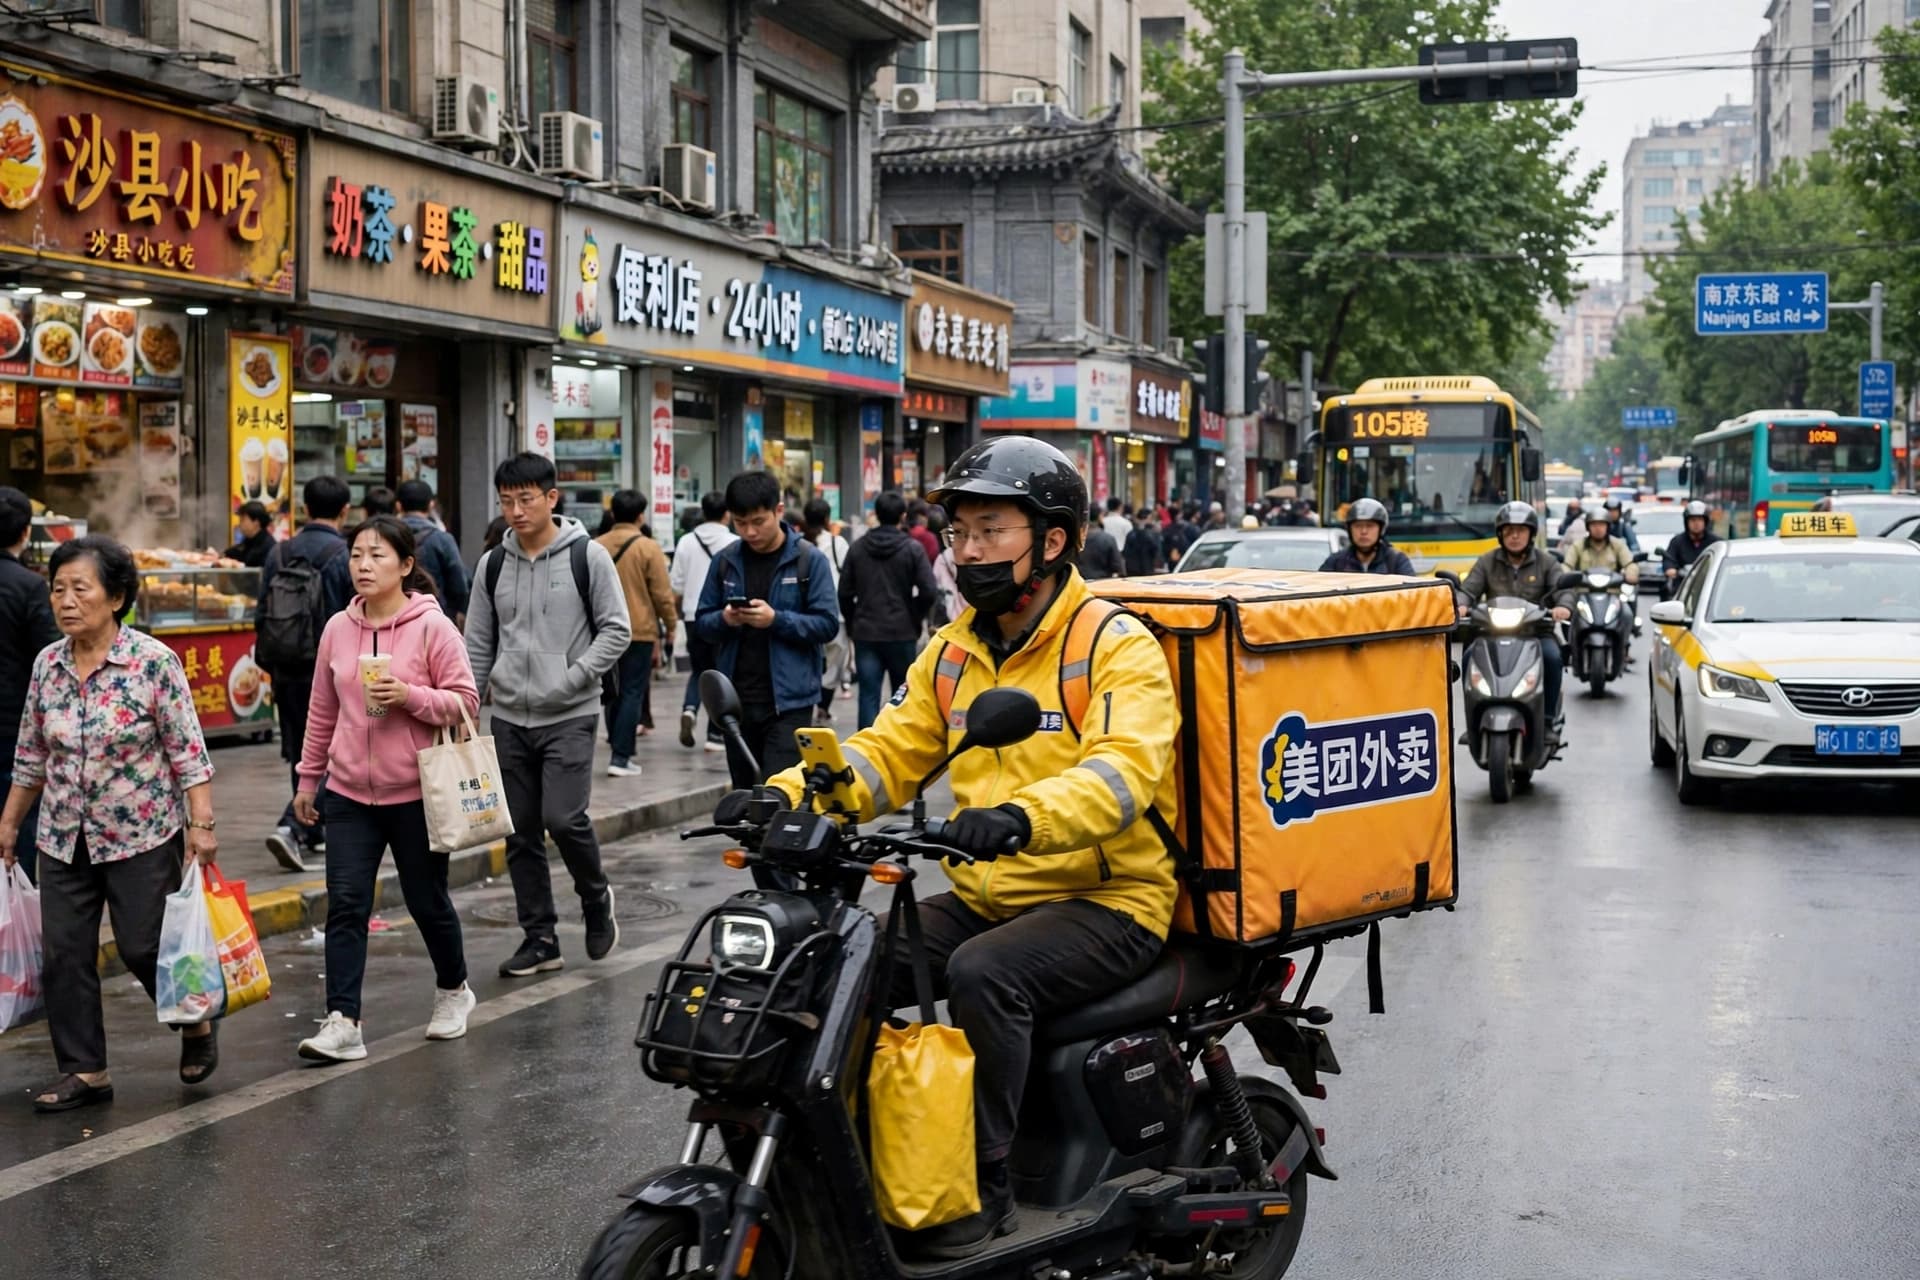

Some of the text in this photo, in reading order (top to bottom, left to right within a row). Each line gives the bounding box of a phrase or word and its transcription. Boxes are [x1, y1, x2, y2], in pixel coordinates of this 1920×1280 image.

[62, 112, 264, 243] 沙县小吃
[1703, 308, 1801, 329] Nanjing East Rd
[1352, 408, 1430, 438] 105路
[1791, 515, 1848, 534] 出租车
[1282, 725, 1431, 804] 美团外卖
